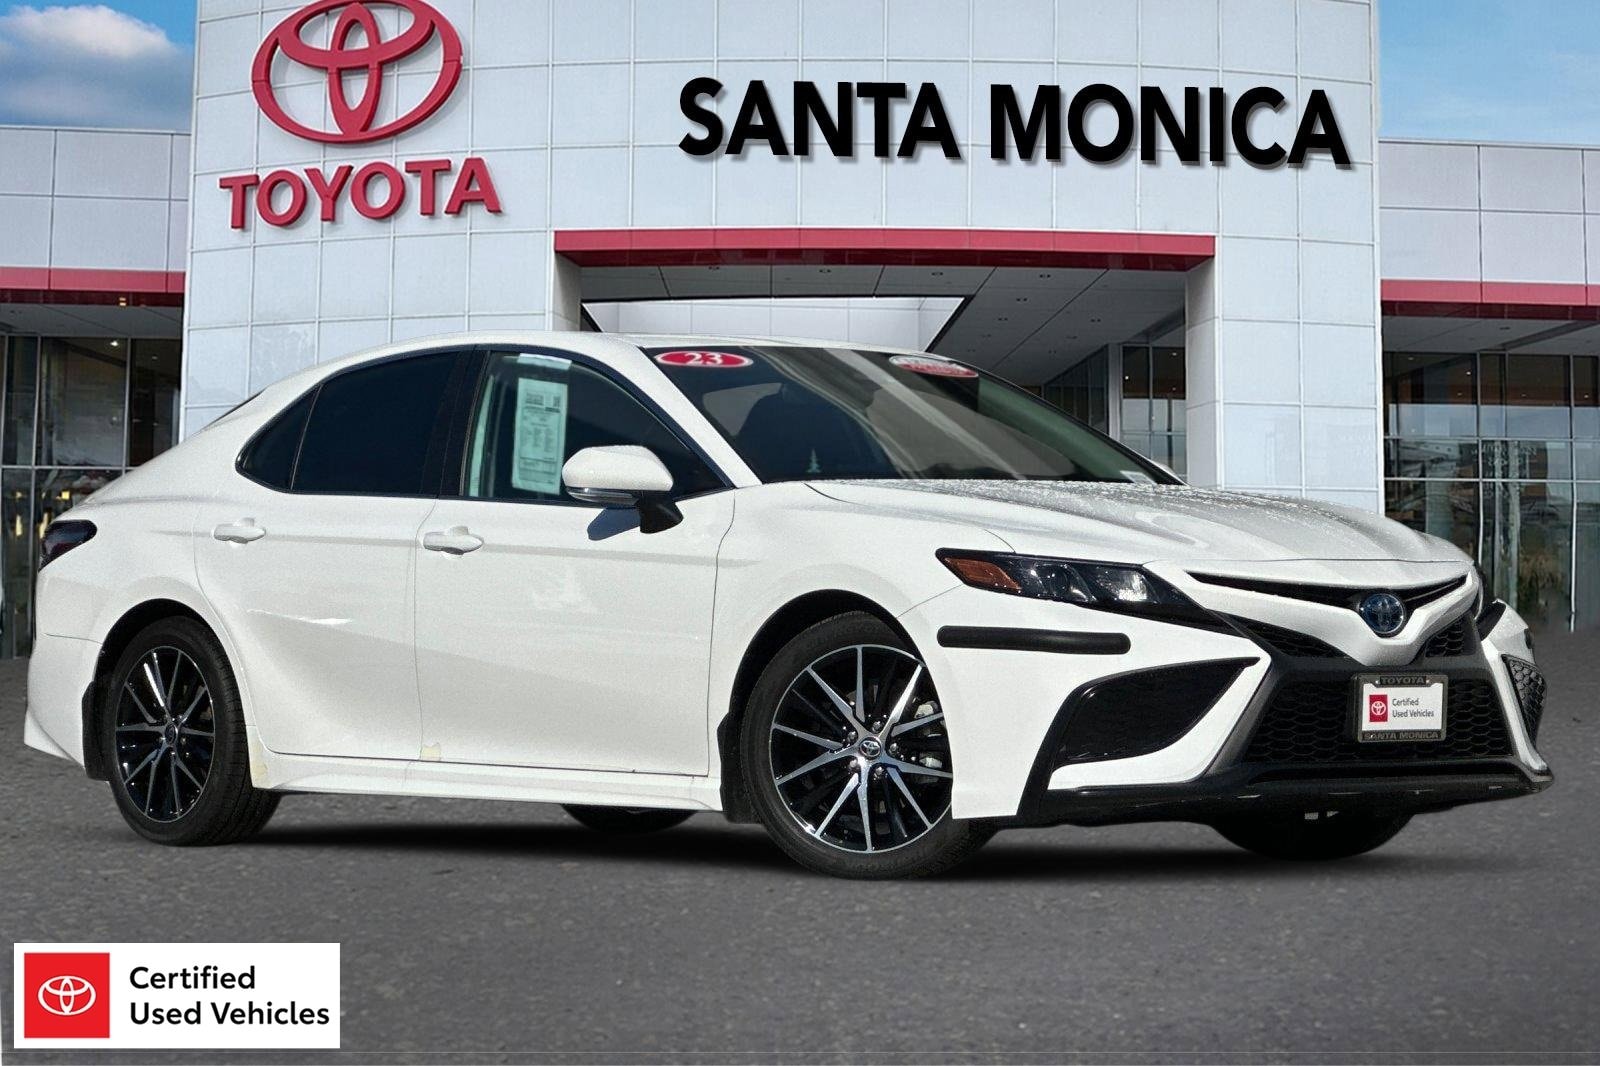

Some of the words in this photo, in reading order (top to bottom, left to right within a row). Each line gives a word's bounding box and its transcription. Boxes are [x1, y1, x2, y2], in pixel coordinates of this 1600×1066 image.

[678, 77, 962, 159] SANTA
[990, 83, 1352, 166] MONICA
[219, 157, 502, 229] TOYOTA
[684, 352, 724, 366] 23
[1380, 676, 1425, 685] TOYOTA
[1392, 697, 1420, 706] Certified
[1392, 709, 1408, 718] Used
[1410, 709, 1434, 718] Vehicles
[1364, 731, 1397, 740] SANTA
[1400, 731, 1439, 740] MONICA
